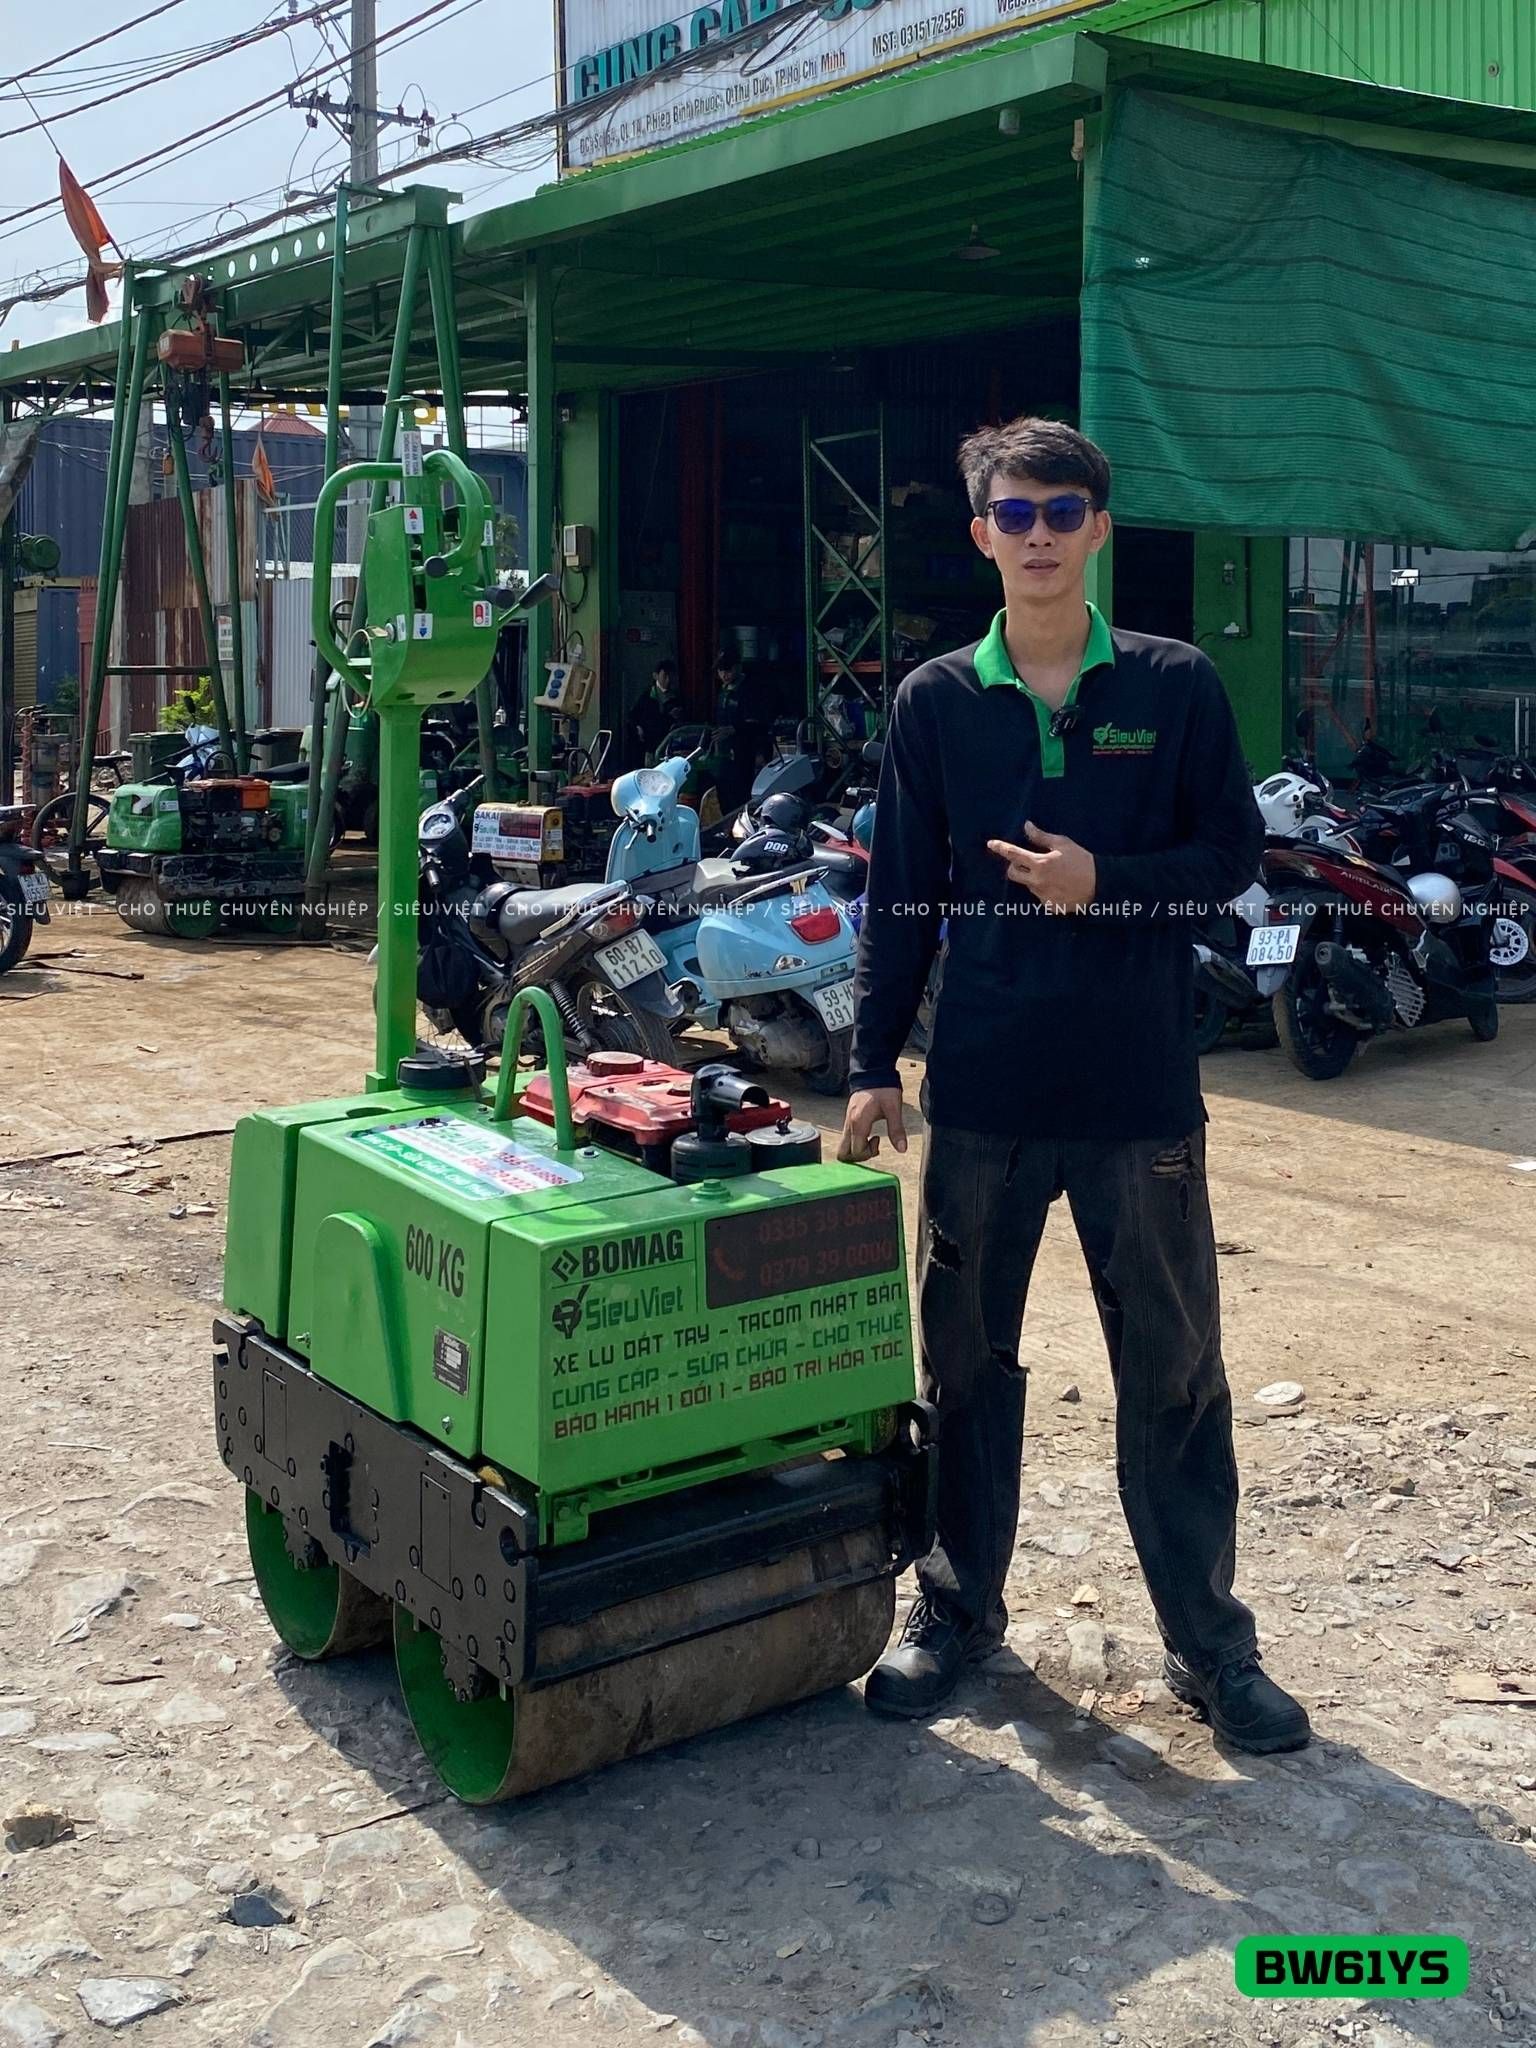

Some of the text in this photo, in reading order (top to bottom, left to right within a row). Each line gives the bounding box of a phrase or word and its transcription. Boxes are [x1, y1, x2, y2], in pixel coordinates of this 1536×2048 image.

[872, 33, 898, 56] MST:
[900, 8, 964, 47] 0315172556
[821, 49, 845, 72] Minh
[474, 810, 499, 820] SAKAI
[605, 935, 643, 966] 60-B7
[1251, 945, 1293, 962] 084.50
[1258, 930, 1290, 945] 93-PA
[613, 950, 661, 983] 112.10
[406, 1224, 465, 1298] 600 KG
[582, 1229, 684, 1278] BOMAG
[586, 1285, 684, 1332] SieuViet
[553, 1353, 579, 1377] XE
[589, 1344, 614, 1368] LU
[673, 1324, 709, 1348] TAY
[738, 1304, 801, 1334] TACOM
[552, 1378, 610, 1410] CUNG
[813, 1324, 849, 1348] CHO
[667, 1394, 673, 1411] 1
[719, 1382, 725, 1399] 1
